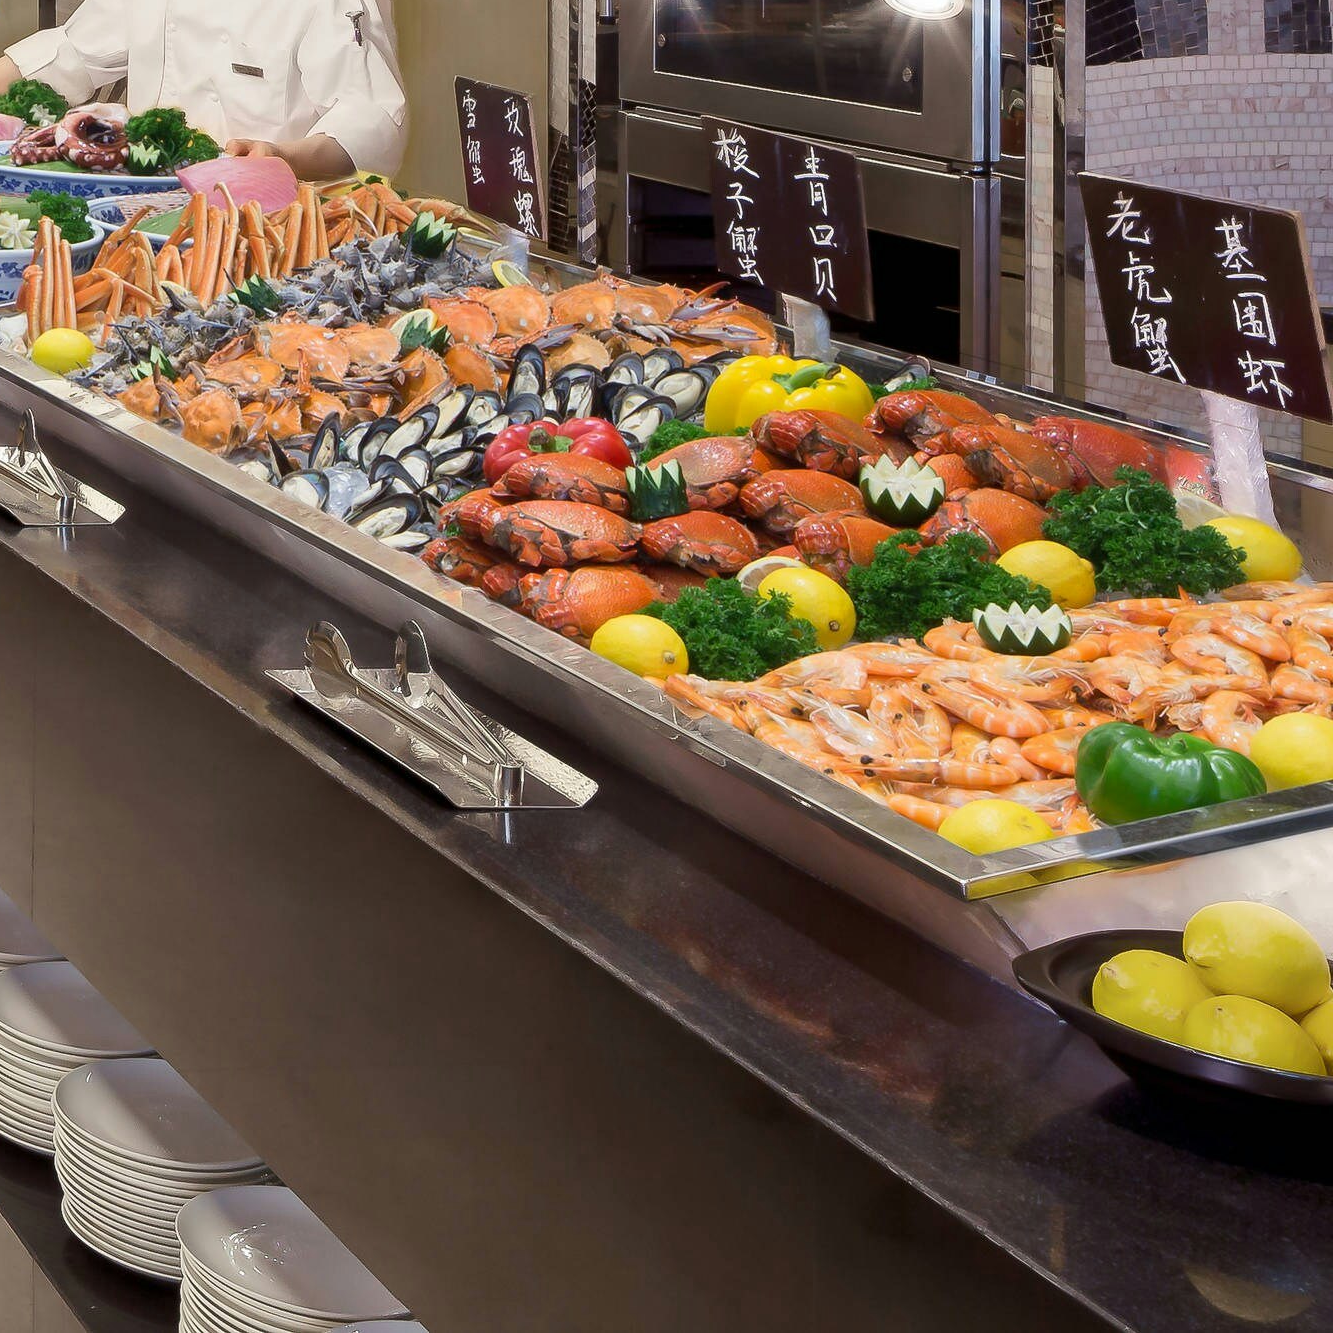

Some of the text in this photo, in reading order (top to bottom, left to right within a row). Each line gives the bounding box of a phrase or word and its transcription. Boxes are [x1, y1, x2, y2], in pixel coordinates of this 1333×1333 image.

[712, 127, 765, 286] 梭子蟹
[794, 146, 838, 302] 青口贝
[1106, 191, 1187, 385] 老虎蟹
[1214, 214, 1294, 409] 基围虾
